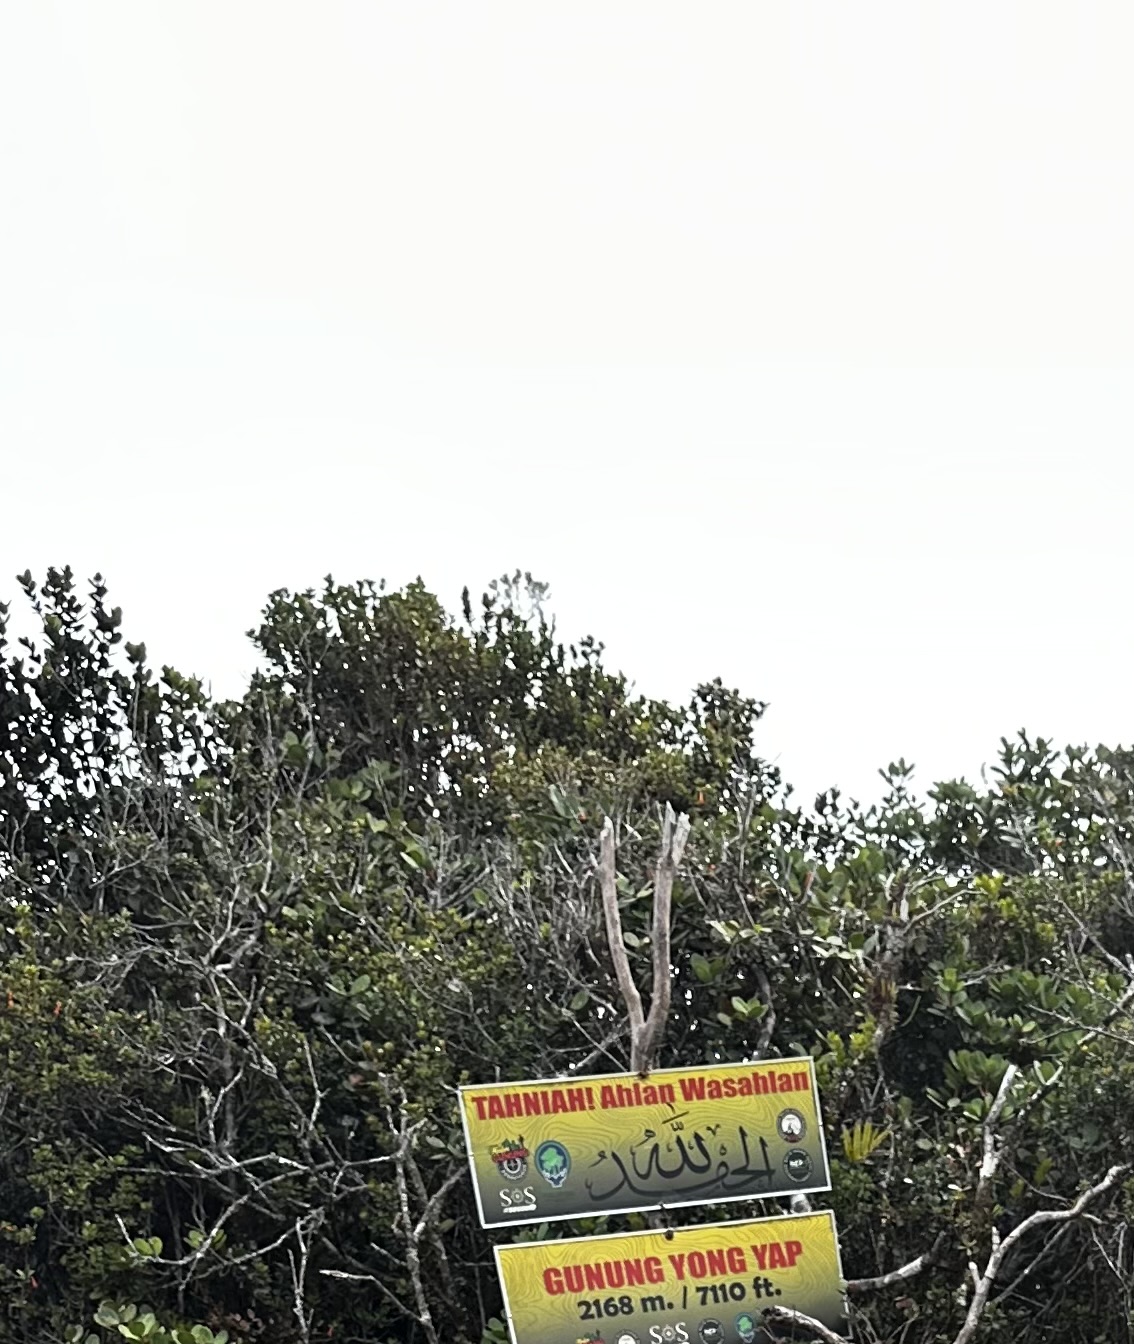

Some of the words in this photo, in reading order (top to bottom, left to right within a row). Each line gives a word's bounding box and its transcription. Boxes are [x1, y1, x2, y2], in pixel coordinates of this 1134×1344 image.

[471, 1086, 595, 1121] TAHNIAH!
[600, 1082, 675, 1110] Ahlan
[678, 1070, 809, 1102] Wasahlan
[542, 1256, 666, 1296] GUNUNG
[668, 1246, 748, 1281] YONG
[750, 1240, 803, 1271] YAP
[577, 1295, 634, 1320] 2168
[640, 1294, 675, 1313] m.
[682, 1285, 688, 1310] /
[695, 1282, 747, 1306] 7110
[752, 1276, 782, 1299] ft.
